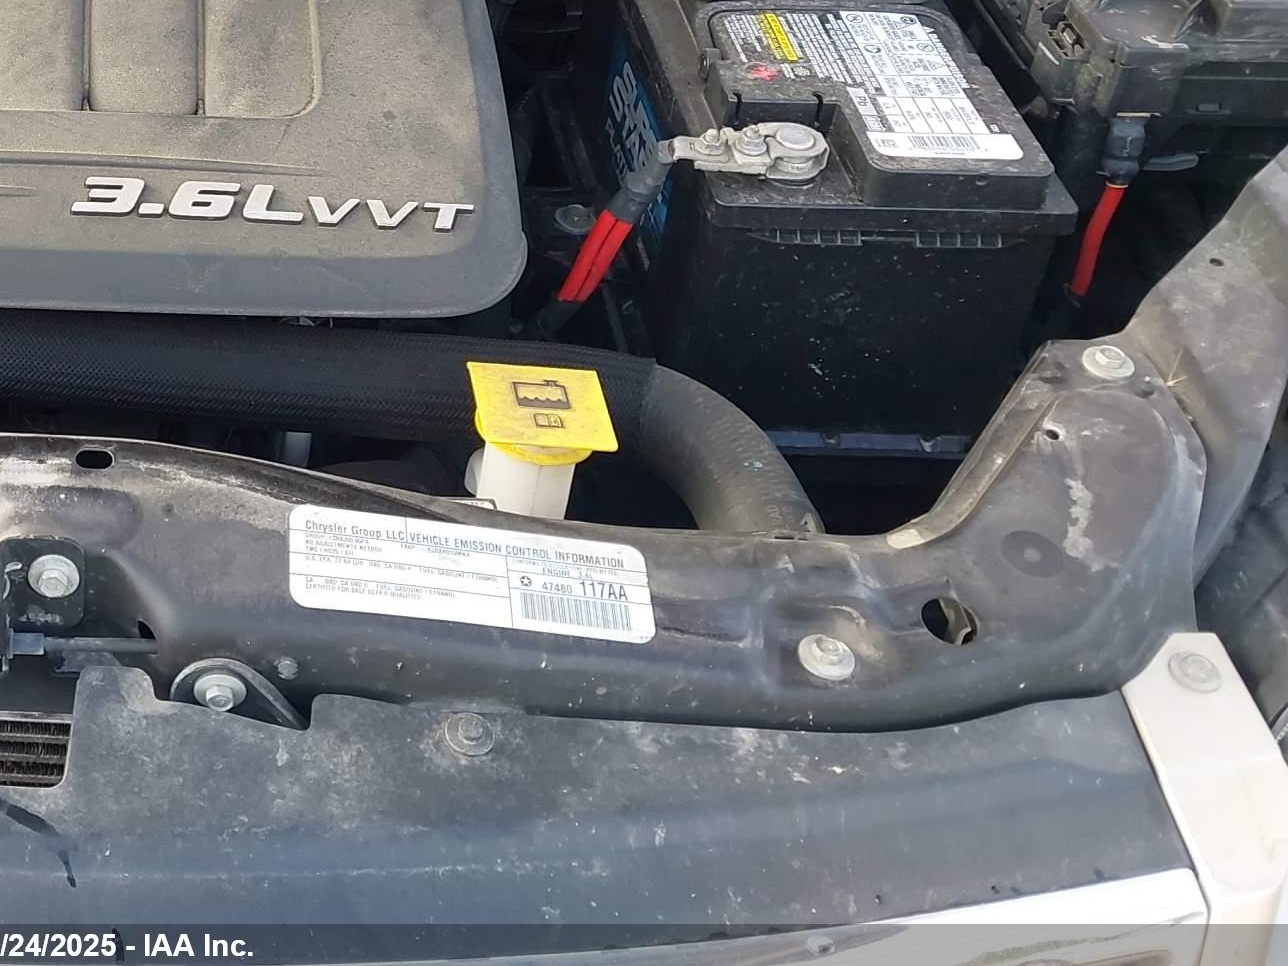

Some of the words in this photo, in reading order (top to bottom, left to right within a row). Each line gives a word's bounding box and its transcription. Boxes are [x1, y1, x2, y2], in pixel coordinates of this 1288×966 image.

[305, 520, 348, 534] Chrysler
[351, 525, 382, 538] Group
[386, 530, 405, 541] LLC
[409, 532, 450, 547] VEHICLE
[454, 538, 502, 553] EMISSION
[505, 545, 552, 560] CONTROL
[555, 551, 624, 568] INFORMATION
[579, 580, 629, 601] 117AA
